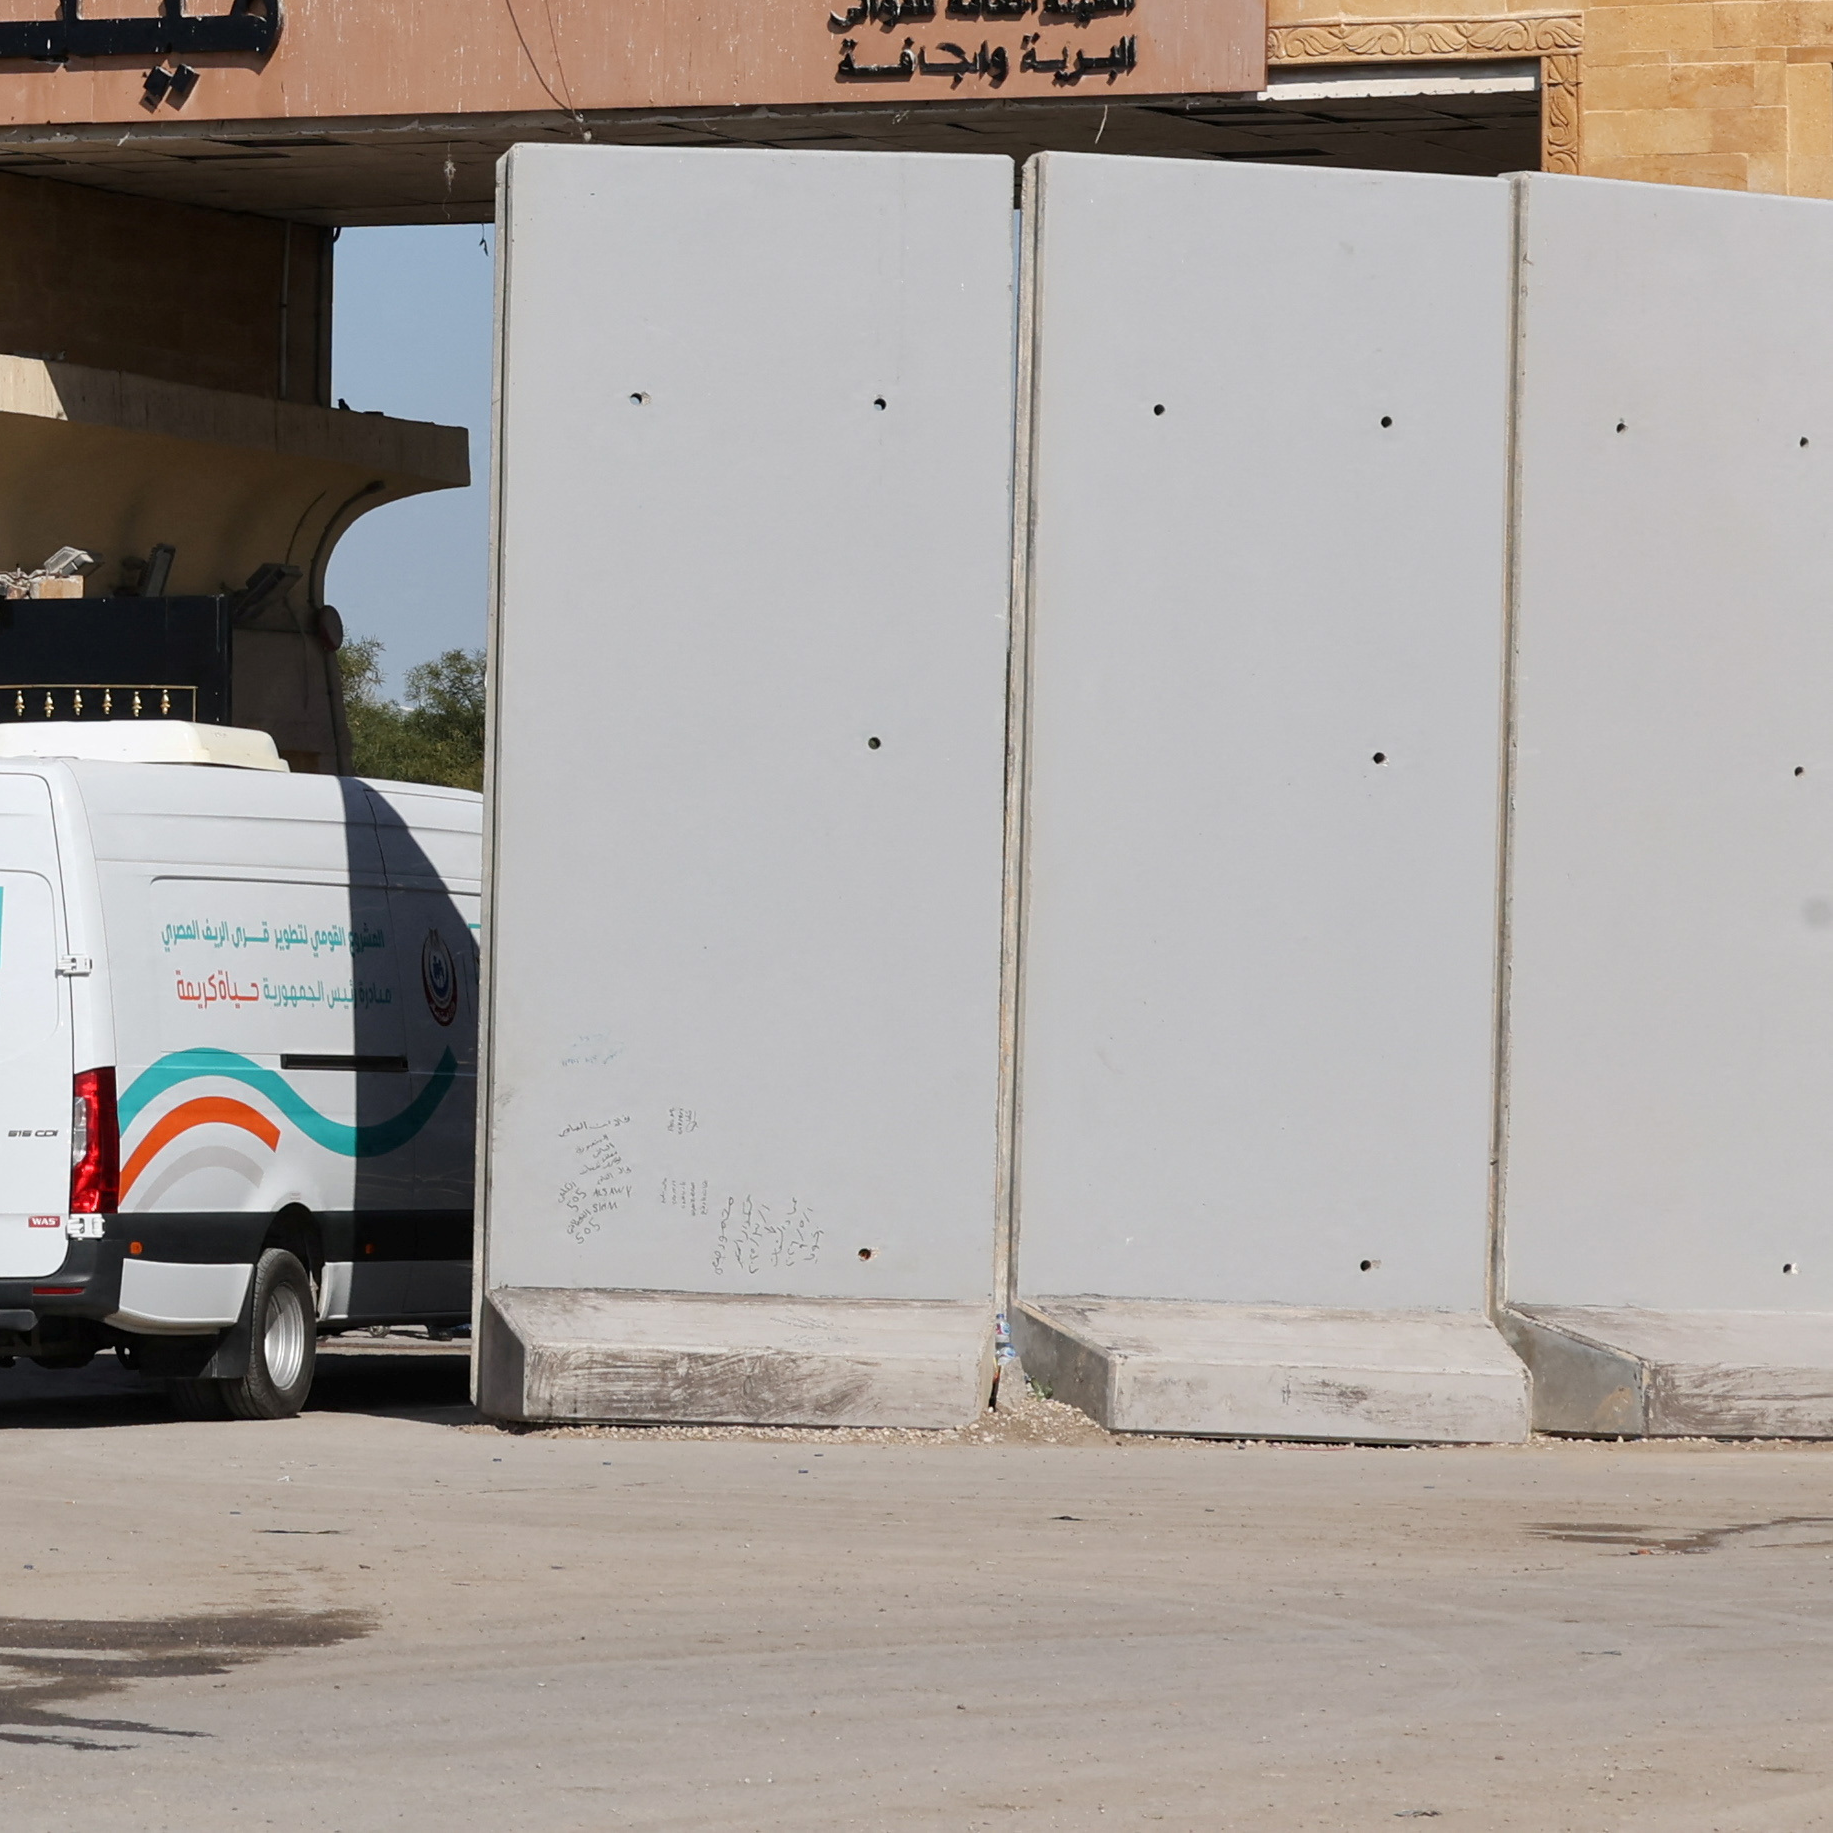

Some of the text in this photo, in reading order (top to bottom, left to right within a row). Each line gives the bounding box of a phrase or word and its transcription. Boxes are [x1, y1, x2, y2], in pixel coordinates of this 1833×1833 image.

[1020, 32, 1138, 84] البرية
[161, 920, 200, 952] المصري
[202, 918, 229, 948] الريف
[274, 924, 308, 951] لتطوير
[310, 925, 346, 958] القومي
[175, 969, 217, 1009] كريمة
[218, 970, 260, 1009] حياة
[263, 977, 324, 1008] الجمهورية
[327, 979, 358, 1009] رئيس
[34, 1129, 59, 1138] CDI
